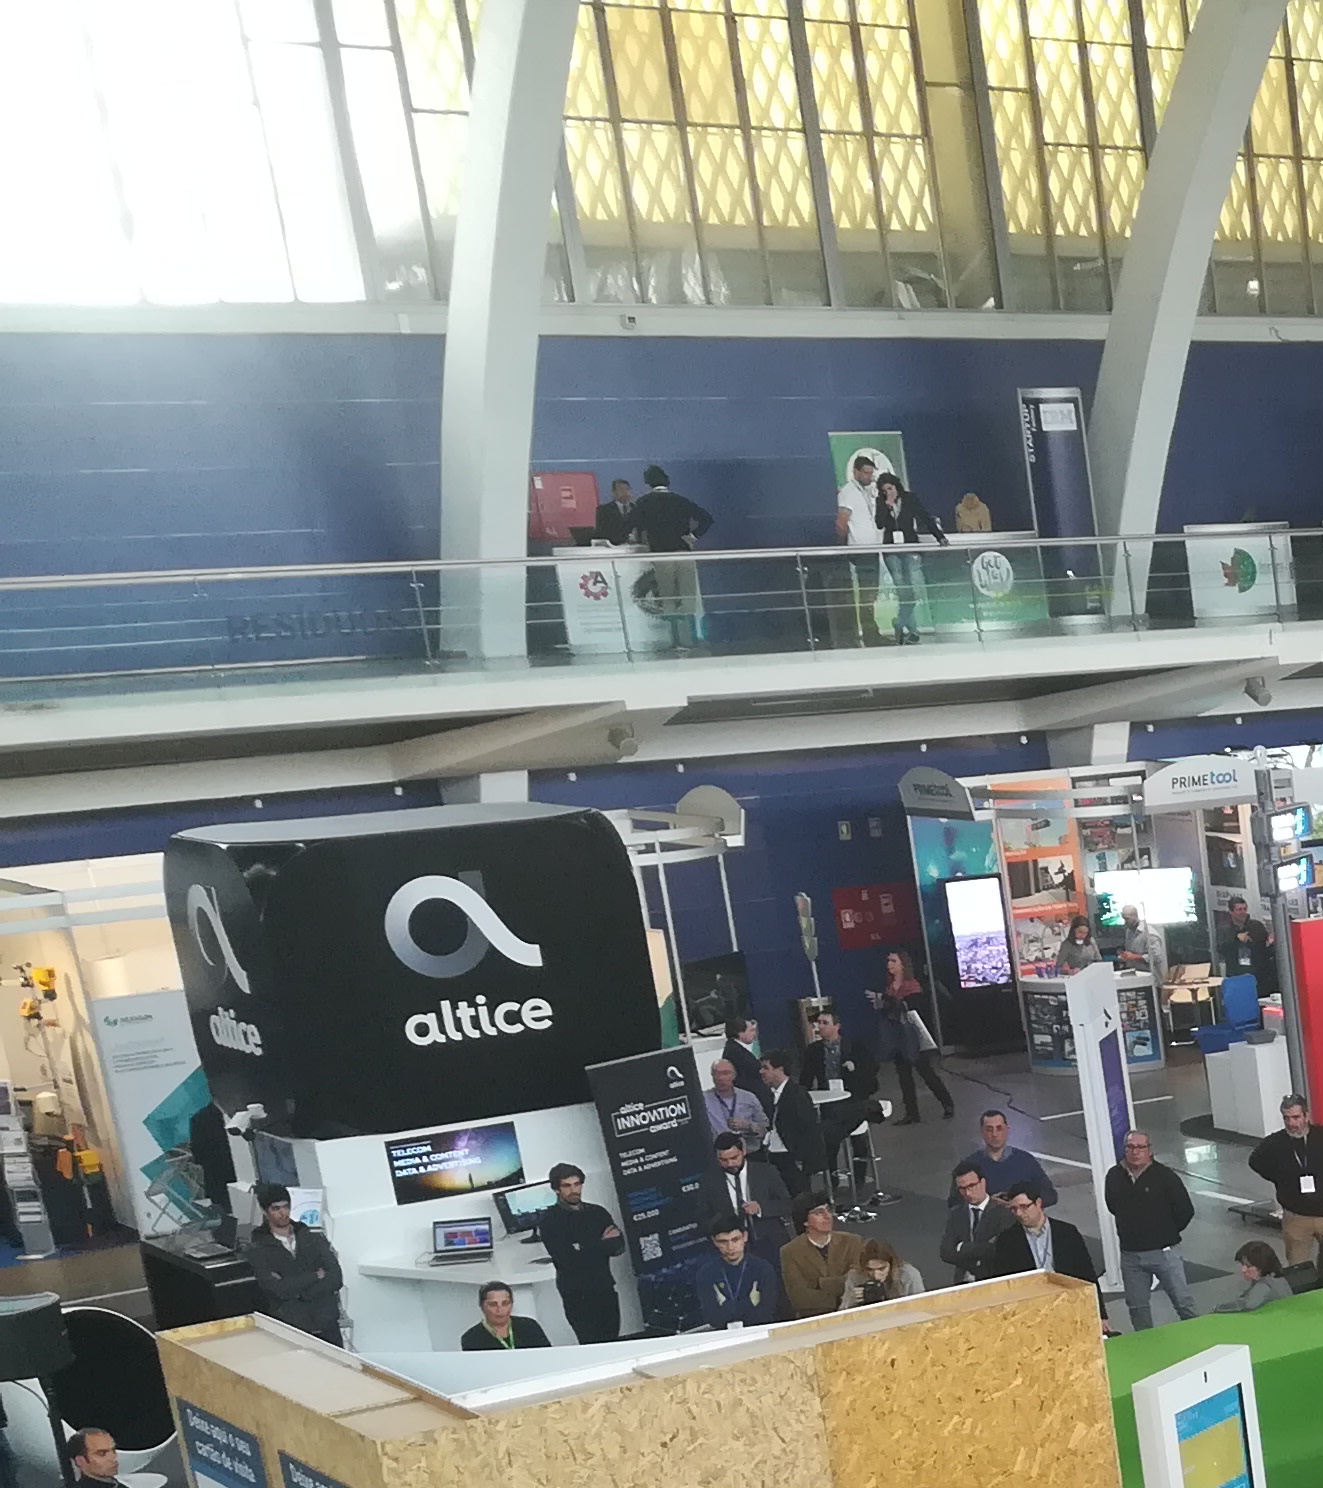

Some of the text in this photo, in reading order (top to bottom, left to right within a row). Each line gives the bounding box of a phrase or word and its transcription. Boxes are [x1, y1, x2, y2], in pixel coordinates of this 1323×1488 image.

[210, 1006, 264, 1056] altice
[405, 995, 554, 1048] altice
[617, 1102, 687, 1130] INNOVATION
[649, 1118, 679, 1134] award
